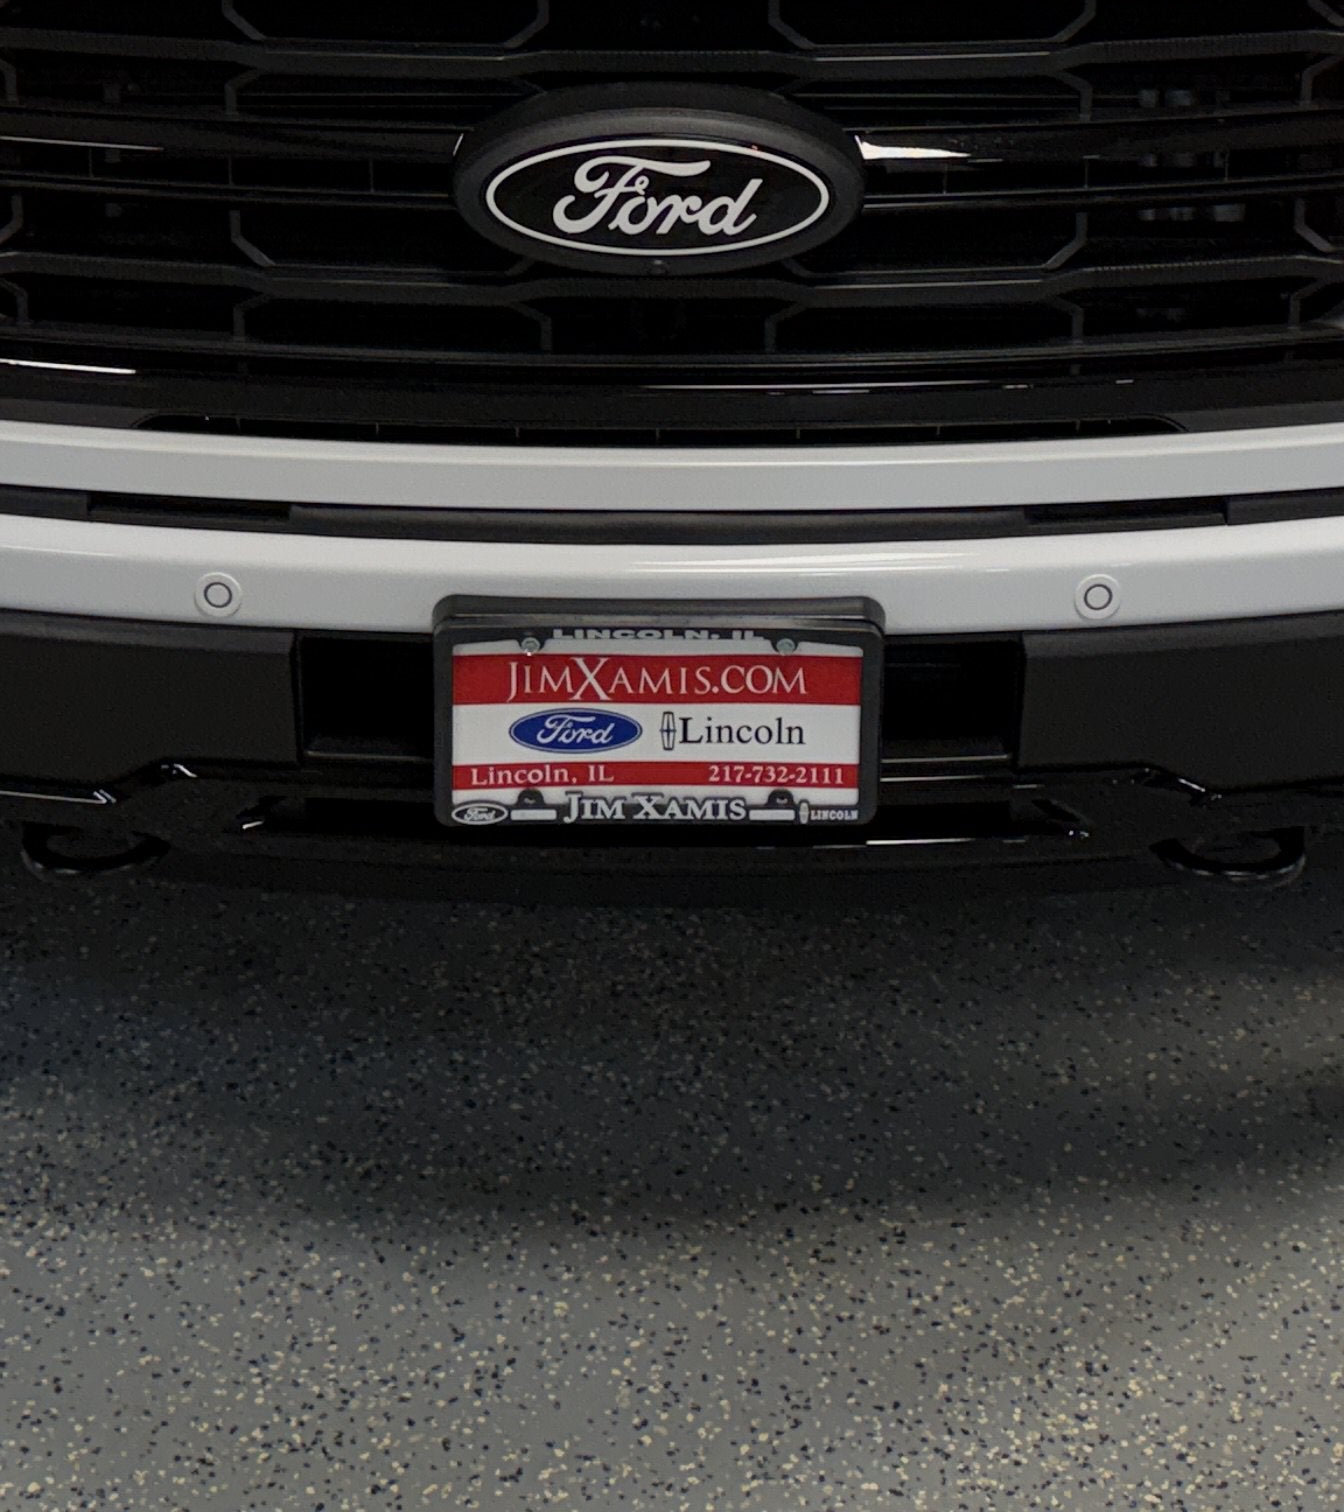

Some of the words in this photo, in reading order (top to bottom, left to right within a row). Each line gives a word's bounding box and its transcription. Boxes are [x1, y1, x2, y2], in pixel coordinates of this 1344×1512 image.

[553, 156, 763, 236] Ford
[506, 657, 808, 702] JIMXAMIS.COM
[536, 714, 615, 745] Ford
[678, 718, 807, 745] Lincoln
[471, 764, 578, 785] Lincoln,
[587, 764, 614, 782] IL
[708, 764, 844, 784] 217-732-2111
[563, 792, 627, 823] JIM
[635, 794, 747, 821] XAMIS
[810, 810, 858, 821] LINCOLN
